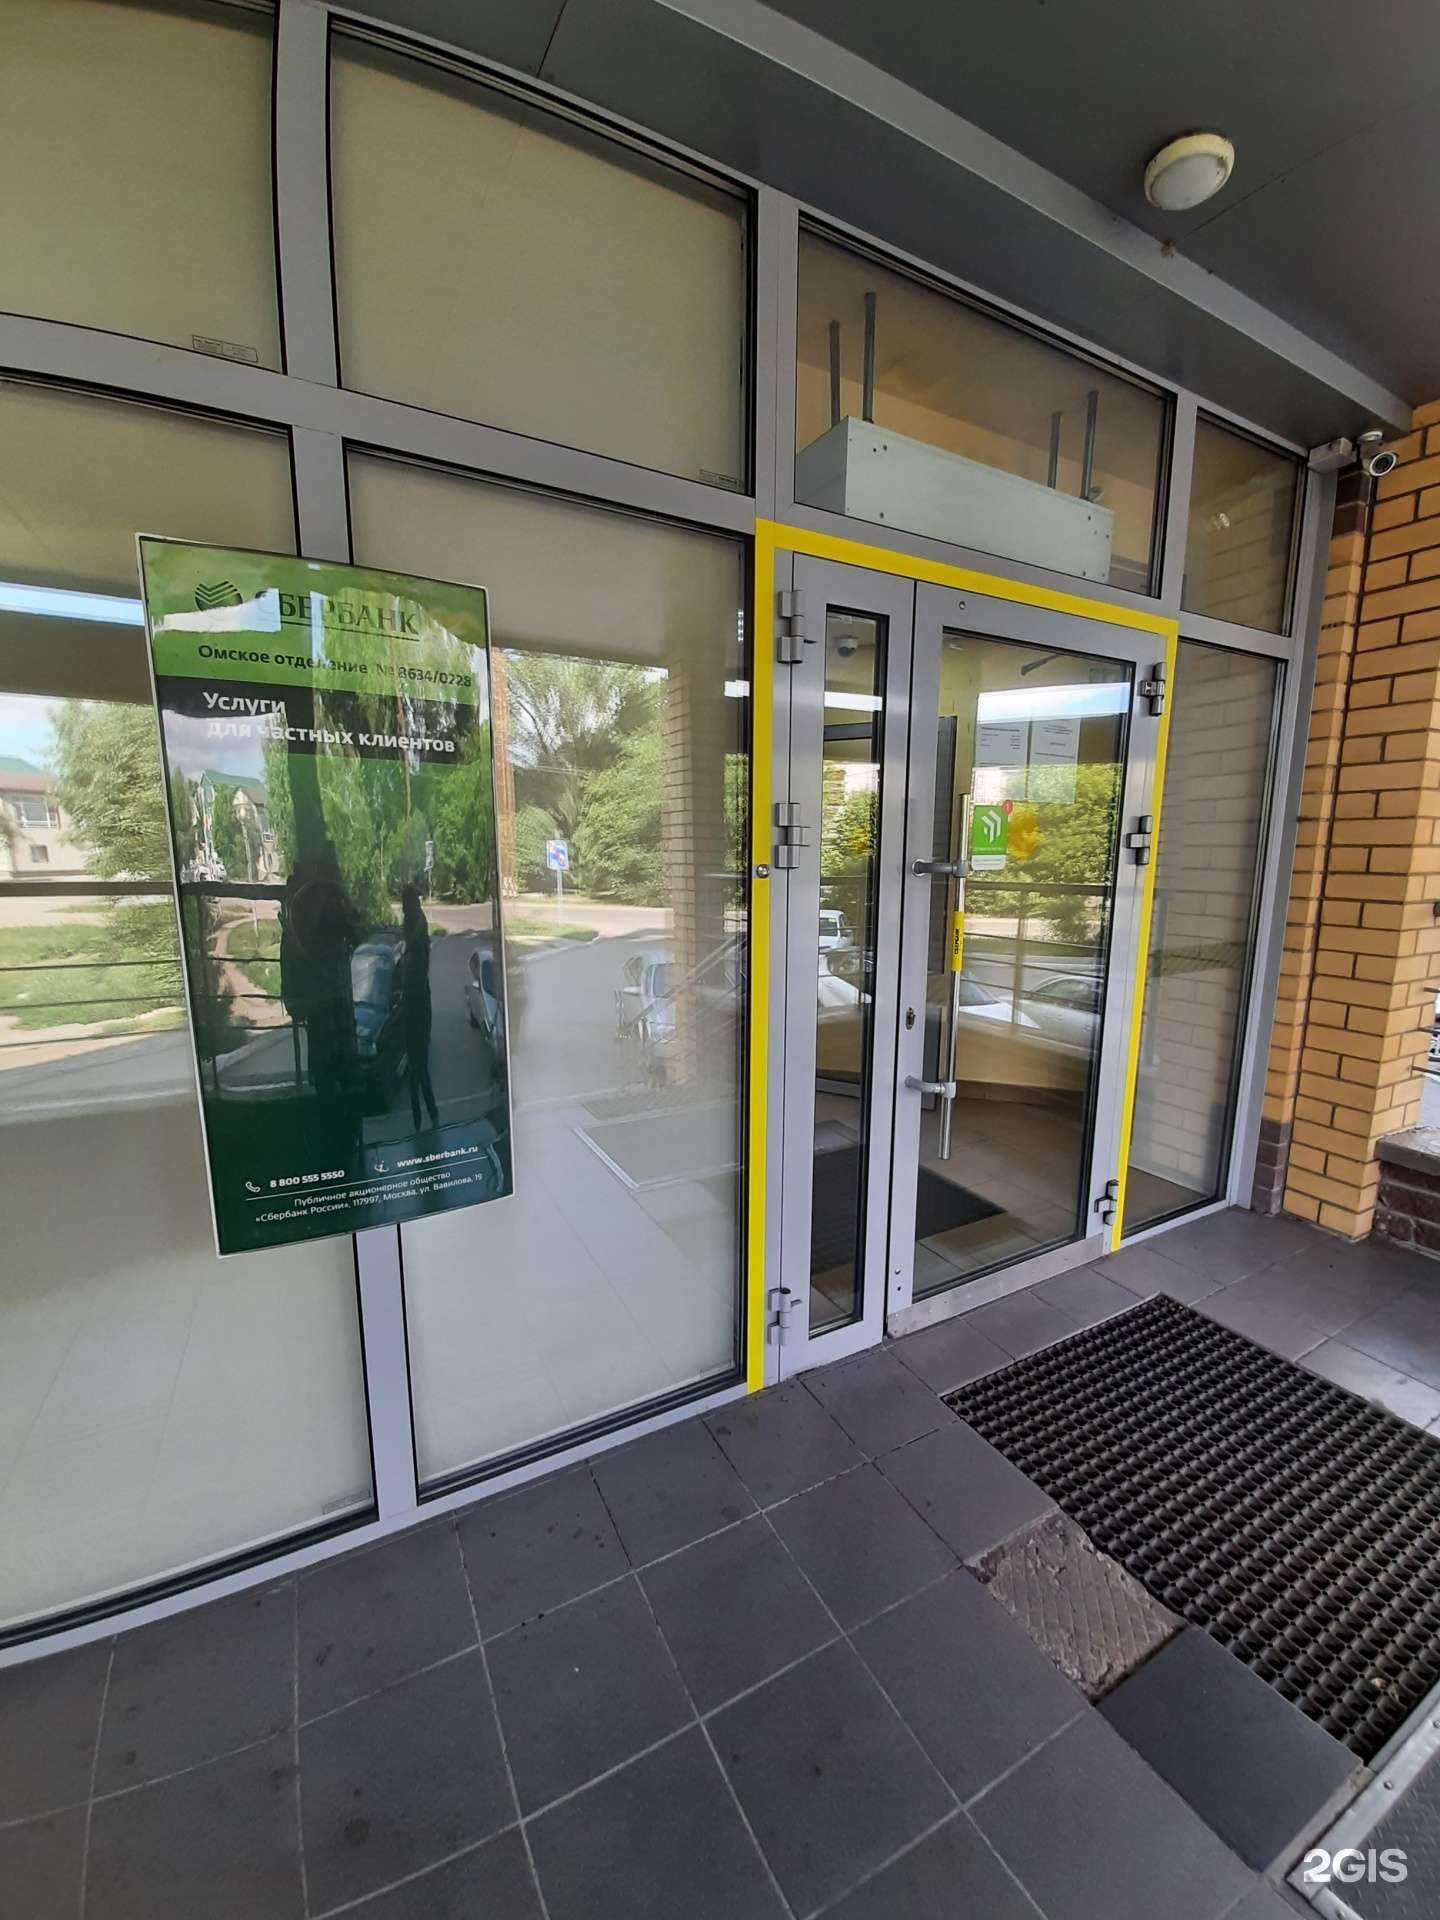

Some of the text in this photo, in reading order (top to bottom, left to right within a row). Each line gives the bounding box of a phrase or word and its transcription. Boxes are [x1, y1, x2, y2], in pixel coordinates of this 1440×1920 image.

[198, 645, 270, 664] Омское
[202, 691, 287, 716] Услуги
[207, 722, 456, 753] для частных клиентов
[396, 1145, 478, 1168] www.sberbank.ru
[269, 1169, 345, 1188] 8 800 555 5550
[294, 1172, 451, 1207] Публичное акционерное общество
